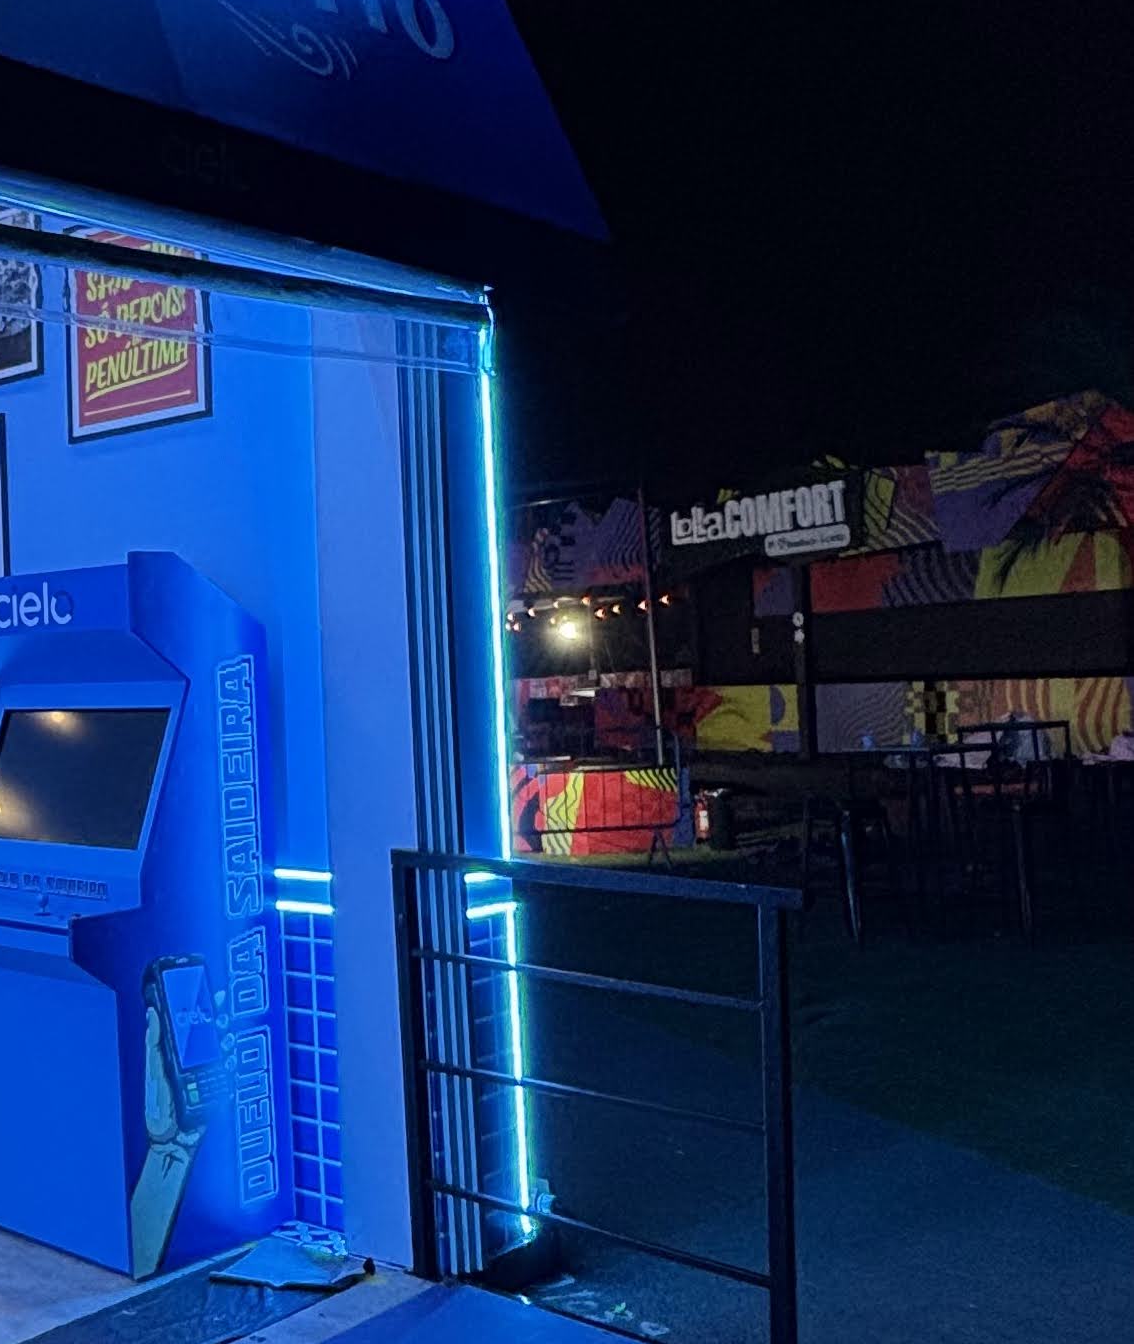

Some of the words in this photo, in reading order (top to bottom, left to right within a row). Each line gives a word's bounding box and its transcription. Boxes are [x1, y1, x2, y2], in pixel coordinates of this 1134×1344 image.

[85, 337, 189, 393] PENÚLTIMA
[217, 655, 264, 920] SAIDEIRA
[227, 925, 270, 1018] DA
[234, 1024, 279, 1207] DUELO
